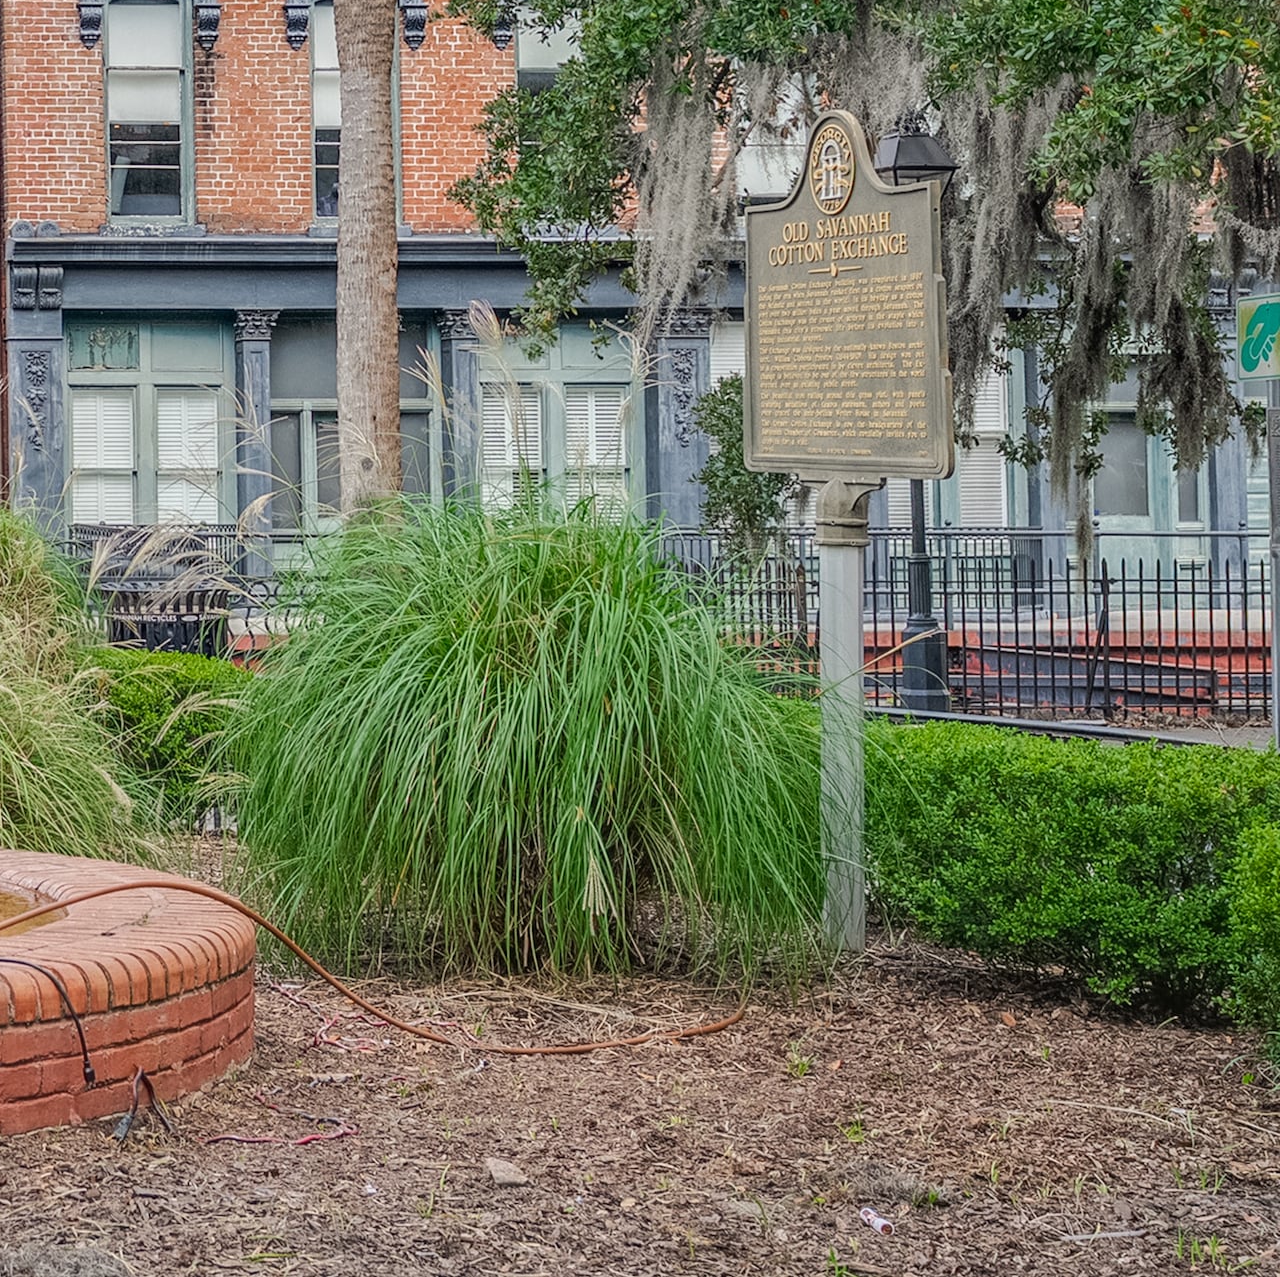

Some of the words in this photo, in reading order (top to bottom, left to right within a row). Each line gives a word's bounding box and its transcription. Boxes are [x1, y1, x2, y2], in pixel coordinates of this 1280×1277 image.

[812, 128, 851, 167] GEORGIA
[782, 221, 809, 244] OLD
[816, 211, 891, 239] SAVANNAH
[768, 241, 825, 266] COTTON
[831, 232, 908, 260] EXCHANGE
[143, 614, 178, 622] RECYCLES
